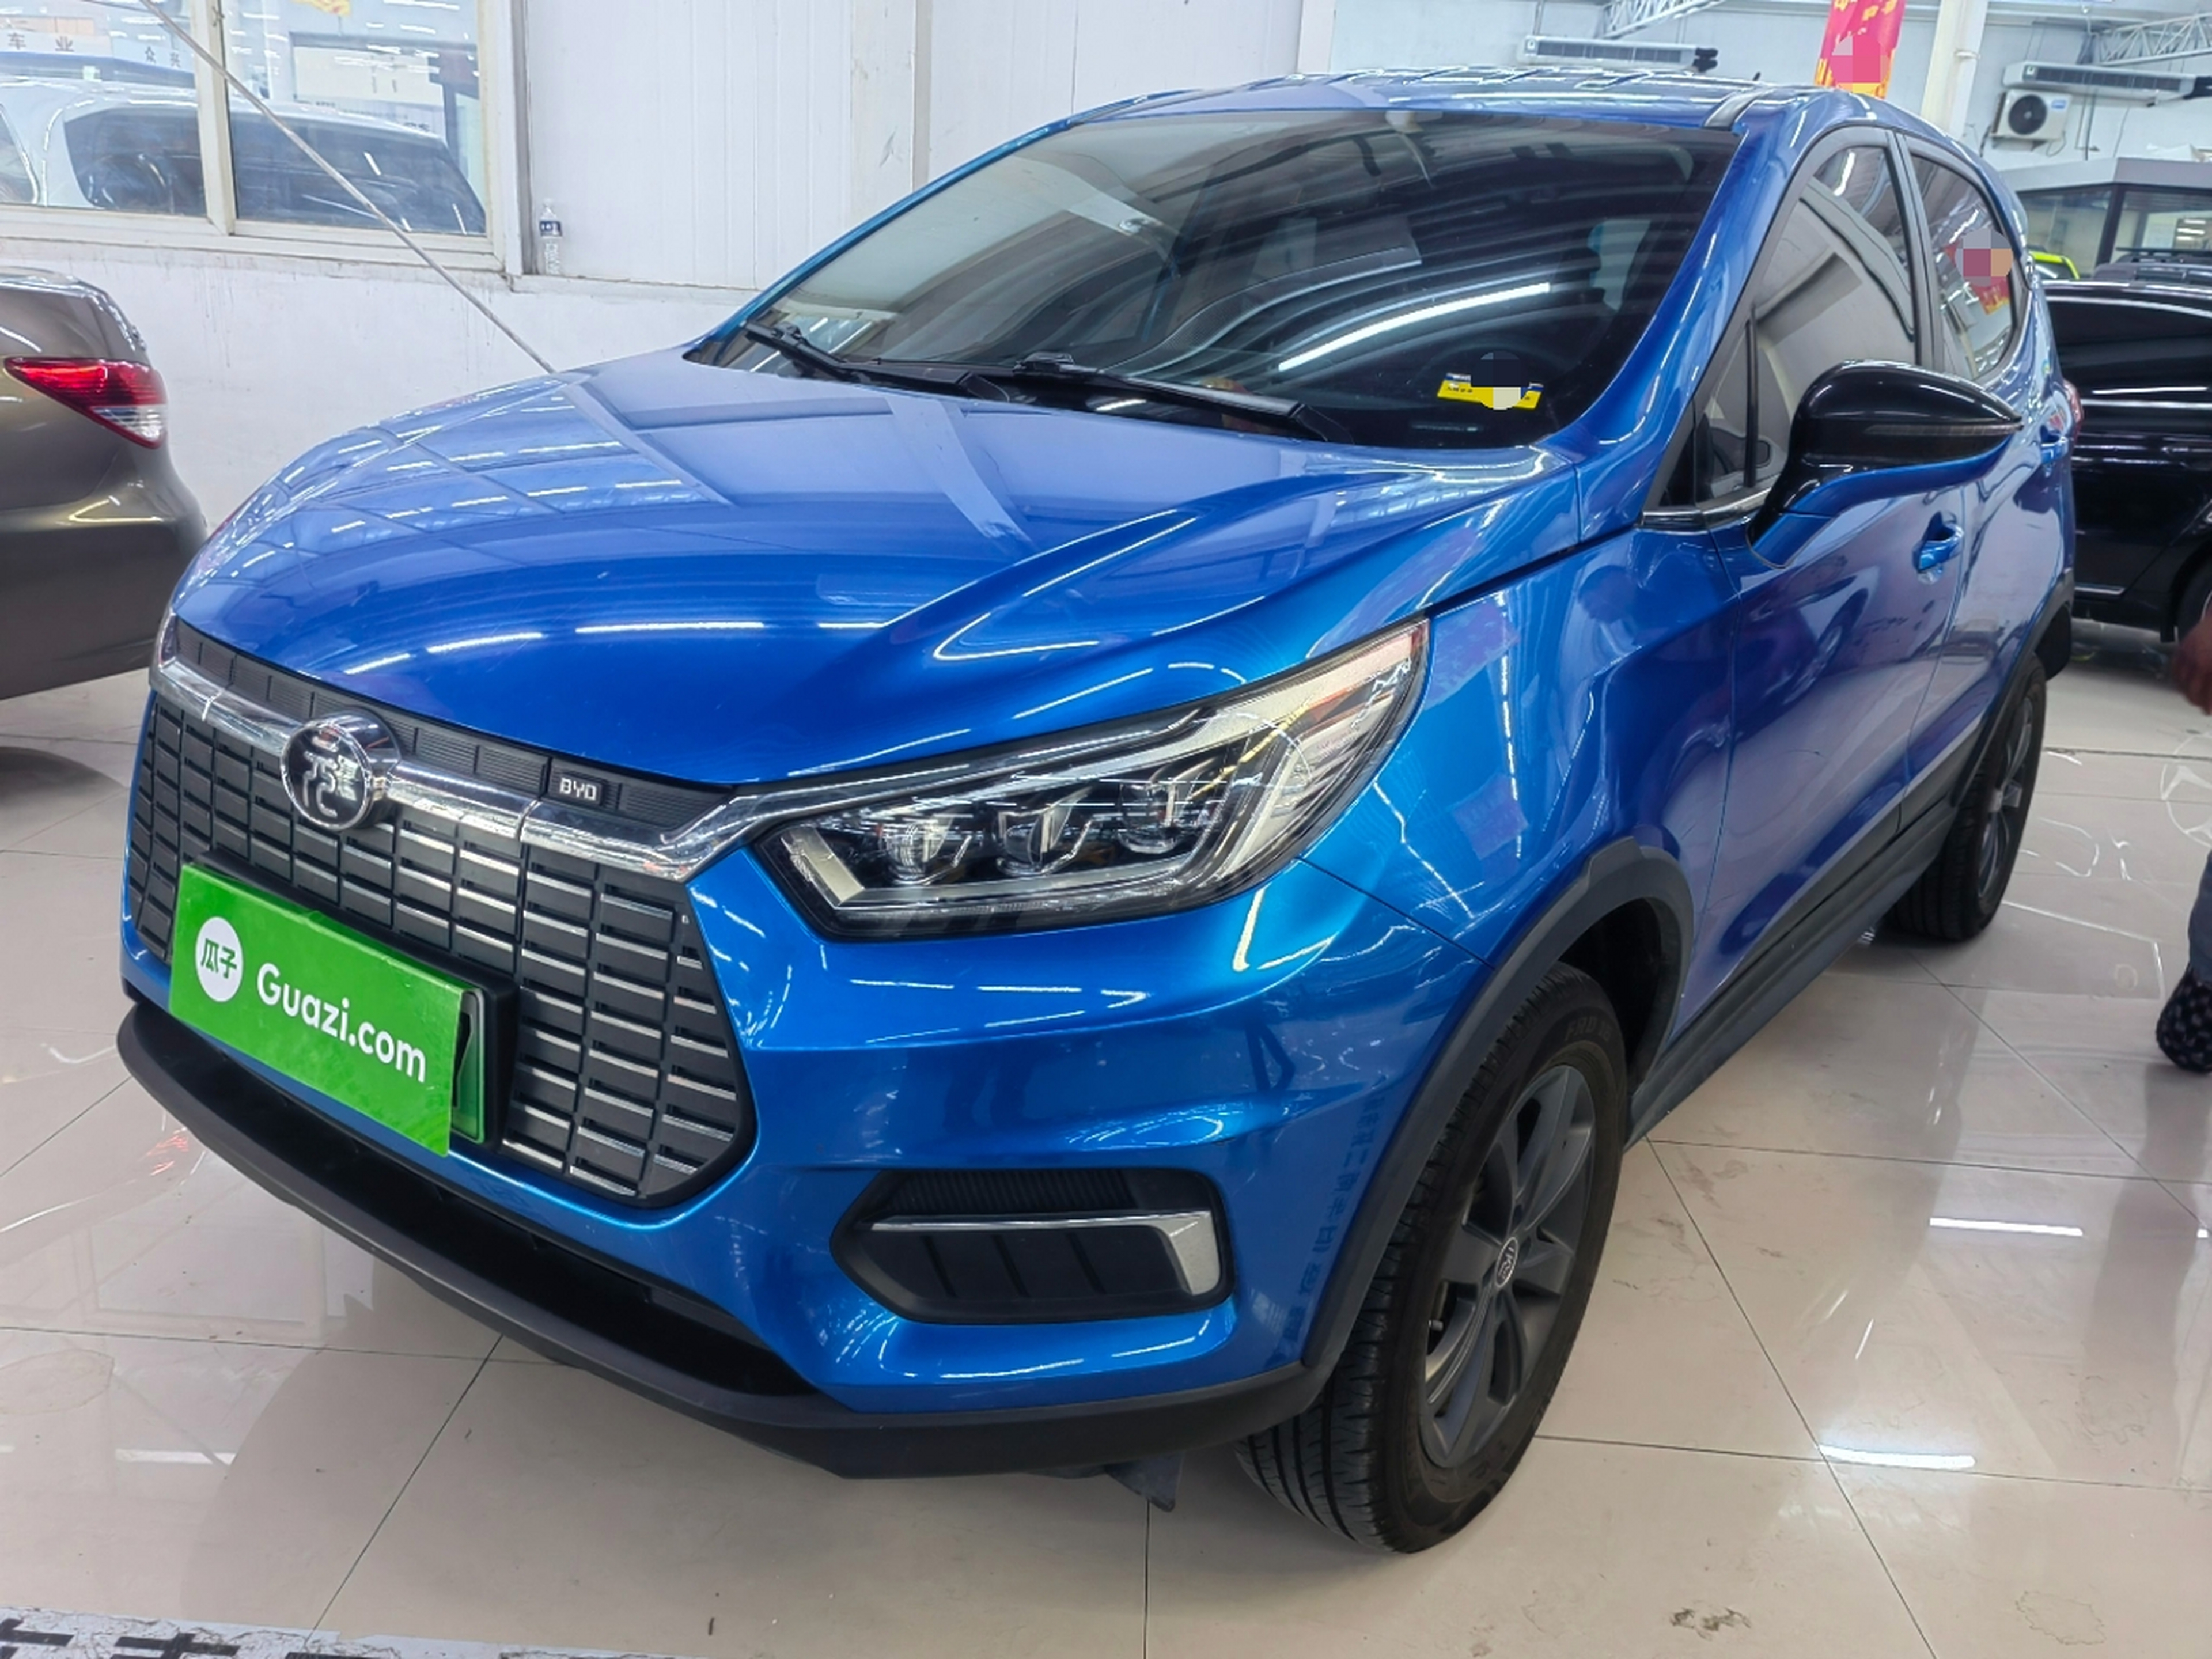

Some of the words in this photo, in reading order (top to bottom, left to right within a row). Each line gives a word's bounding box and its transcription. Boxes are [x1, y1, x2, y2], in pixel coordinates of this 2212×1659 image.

[559, 777, 597, 801] BYD
[200, 938, 237, 979] 瓜子
[257, 963, 426, 1083] Guazi.com
